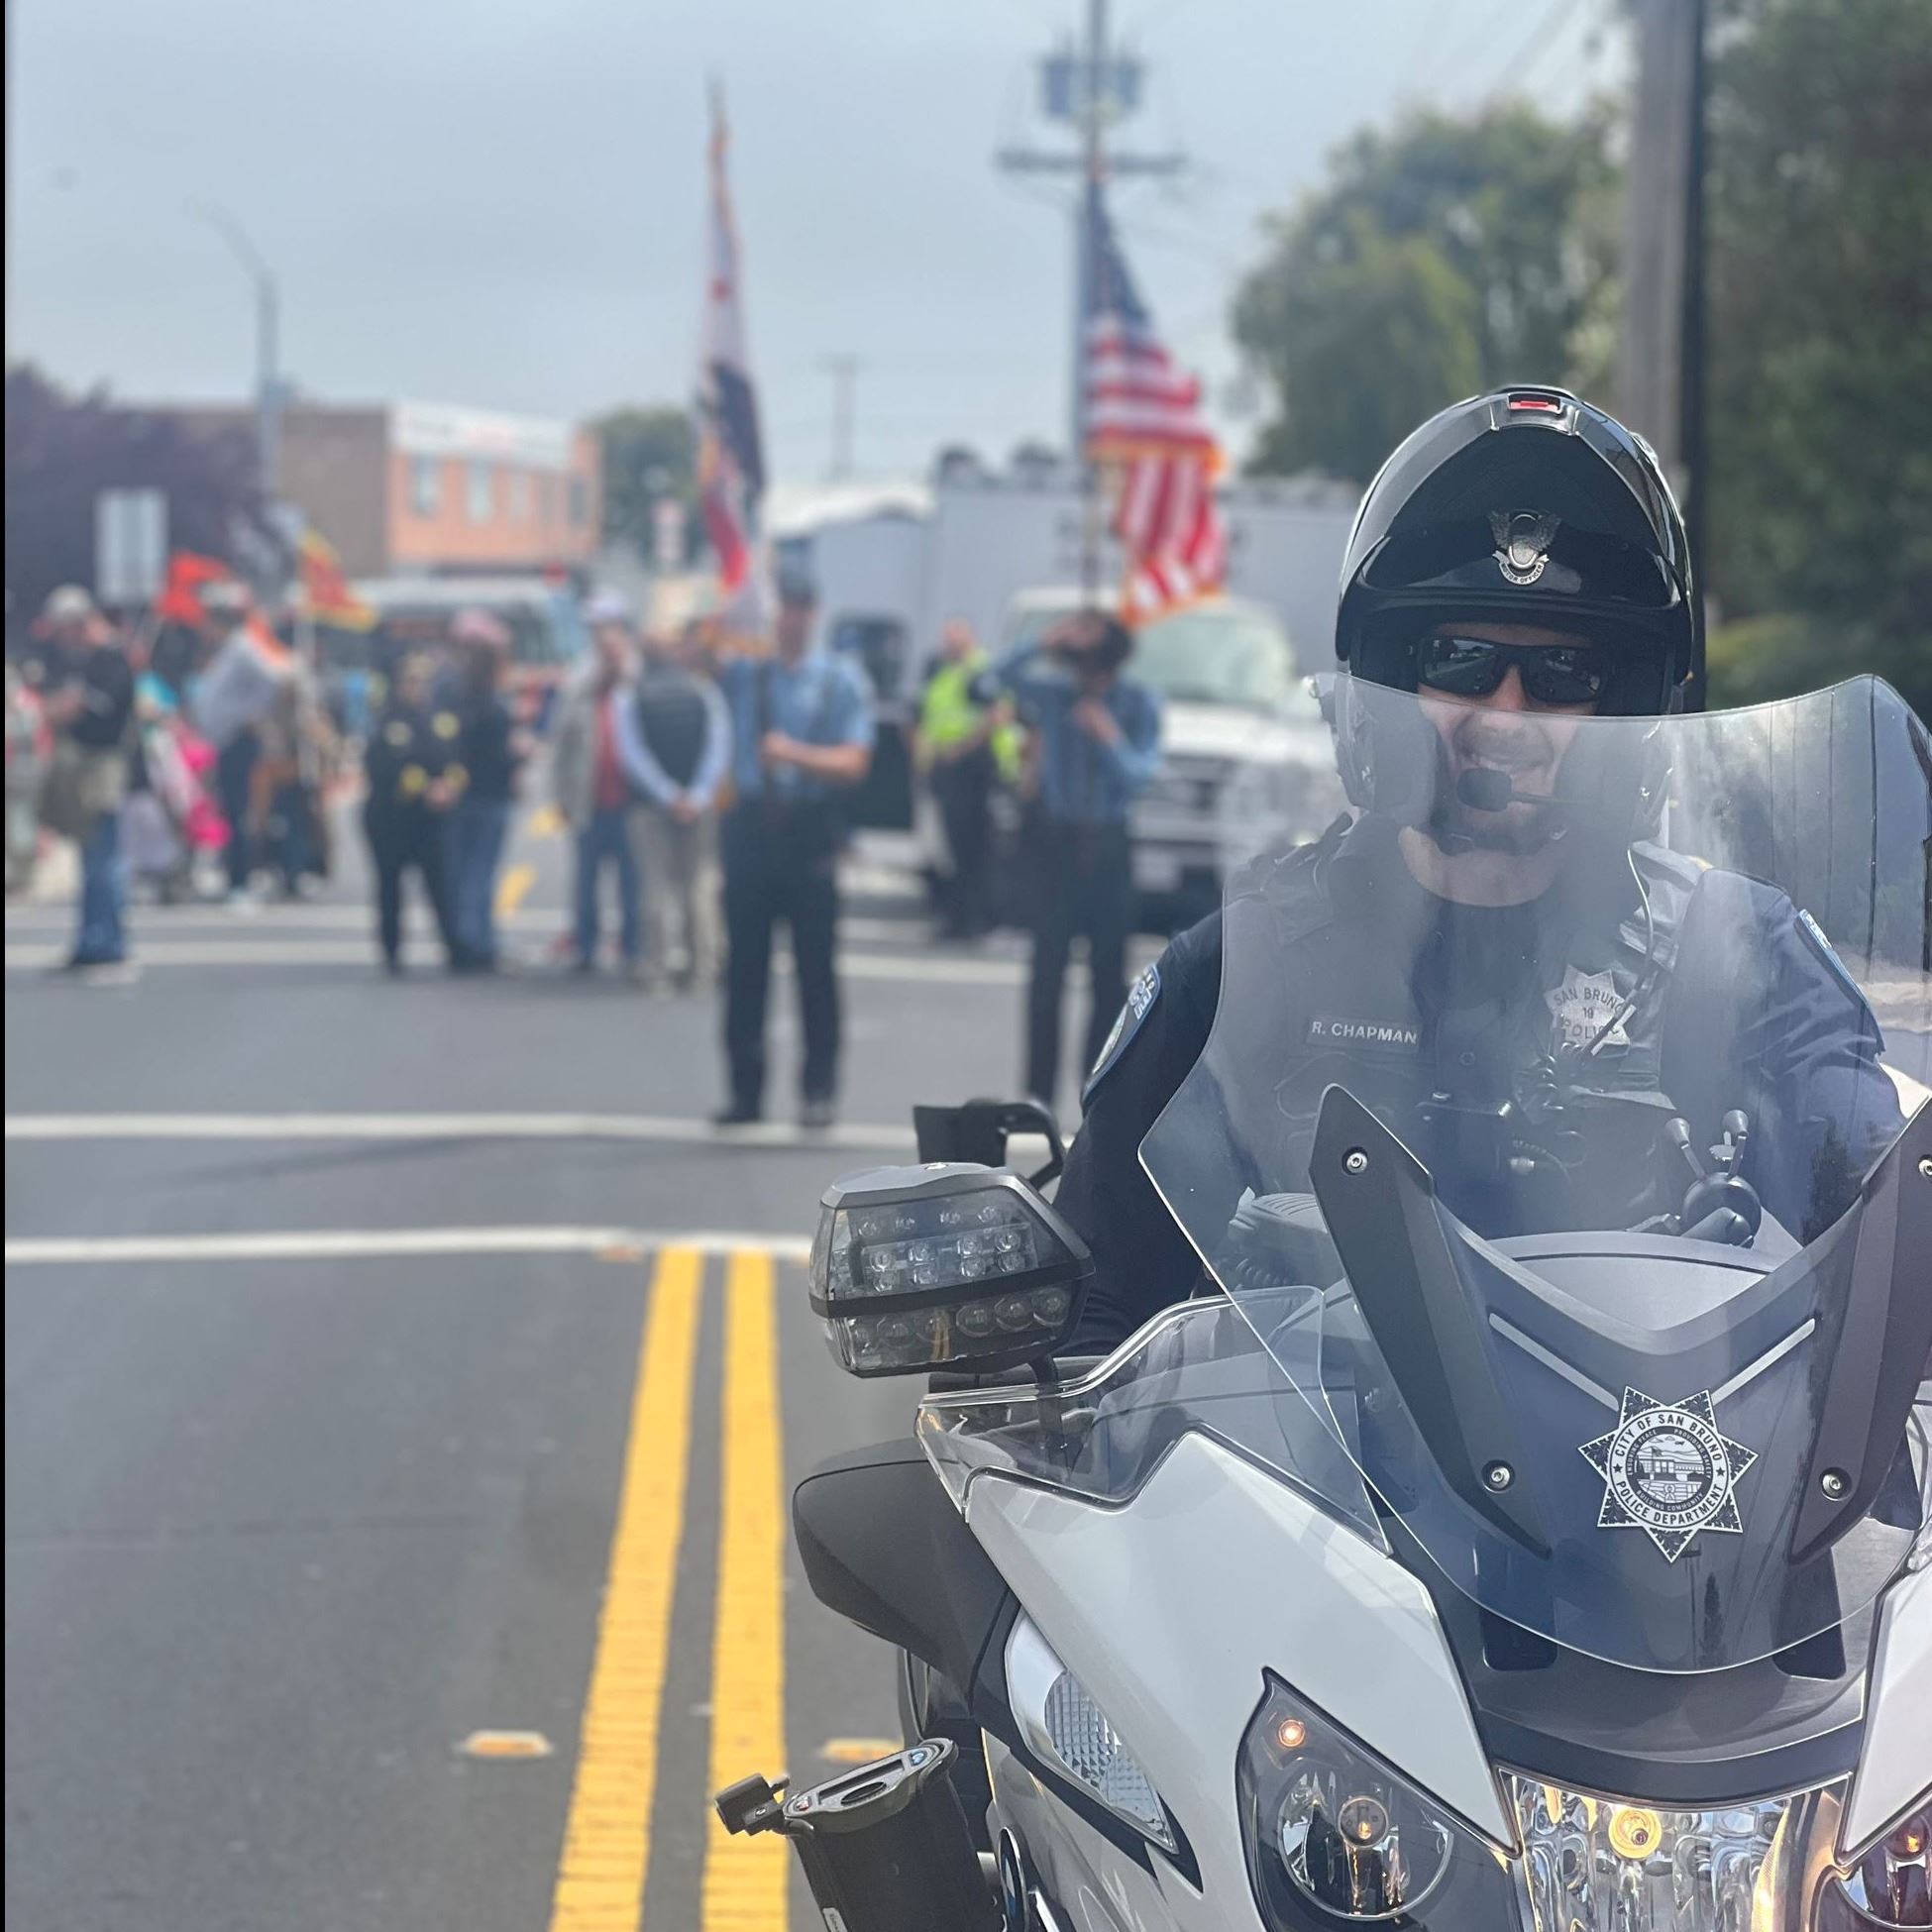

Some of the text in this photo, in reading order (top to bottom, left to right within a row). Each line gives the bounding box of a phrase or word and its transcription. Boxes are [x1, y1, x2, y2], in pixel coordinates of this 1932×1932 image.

[1519, 564, 1544, 584] OFFICER
[1553, 987, 1578, 1007] SAN
[1311, 1020, 1418, 1045] R. CHAPMAN
[1614, 1414, 1723, 1461] CITY OF SAN BRUNO
[1638, 1429, 1658, 1445] PEACE
[1673, 1429, 1712, 1479] PROVIDING SAFETY
[1615, 1480, 1724, 1525] POLICE DEPARTMENT
[1636, 1489, 1704, 1512] BUILDING COMMUNITY
